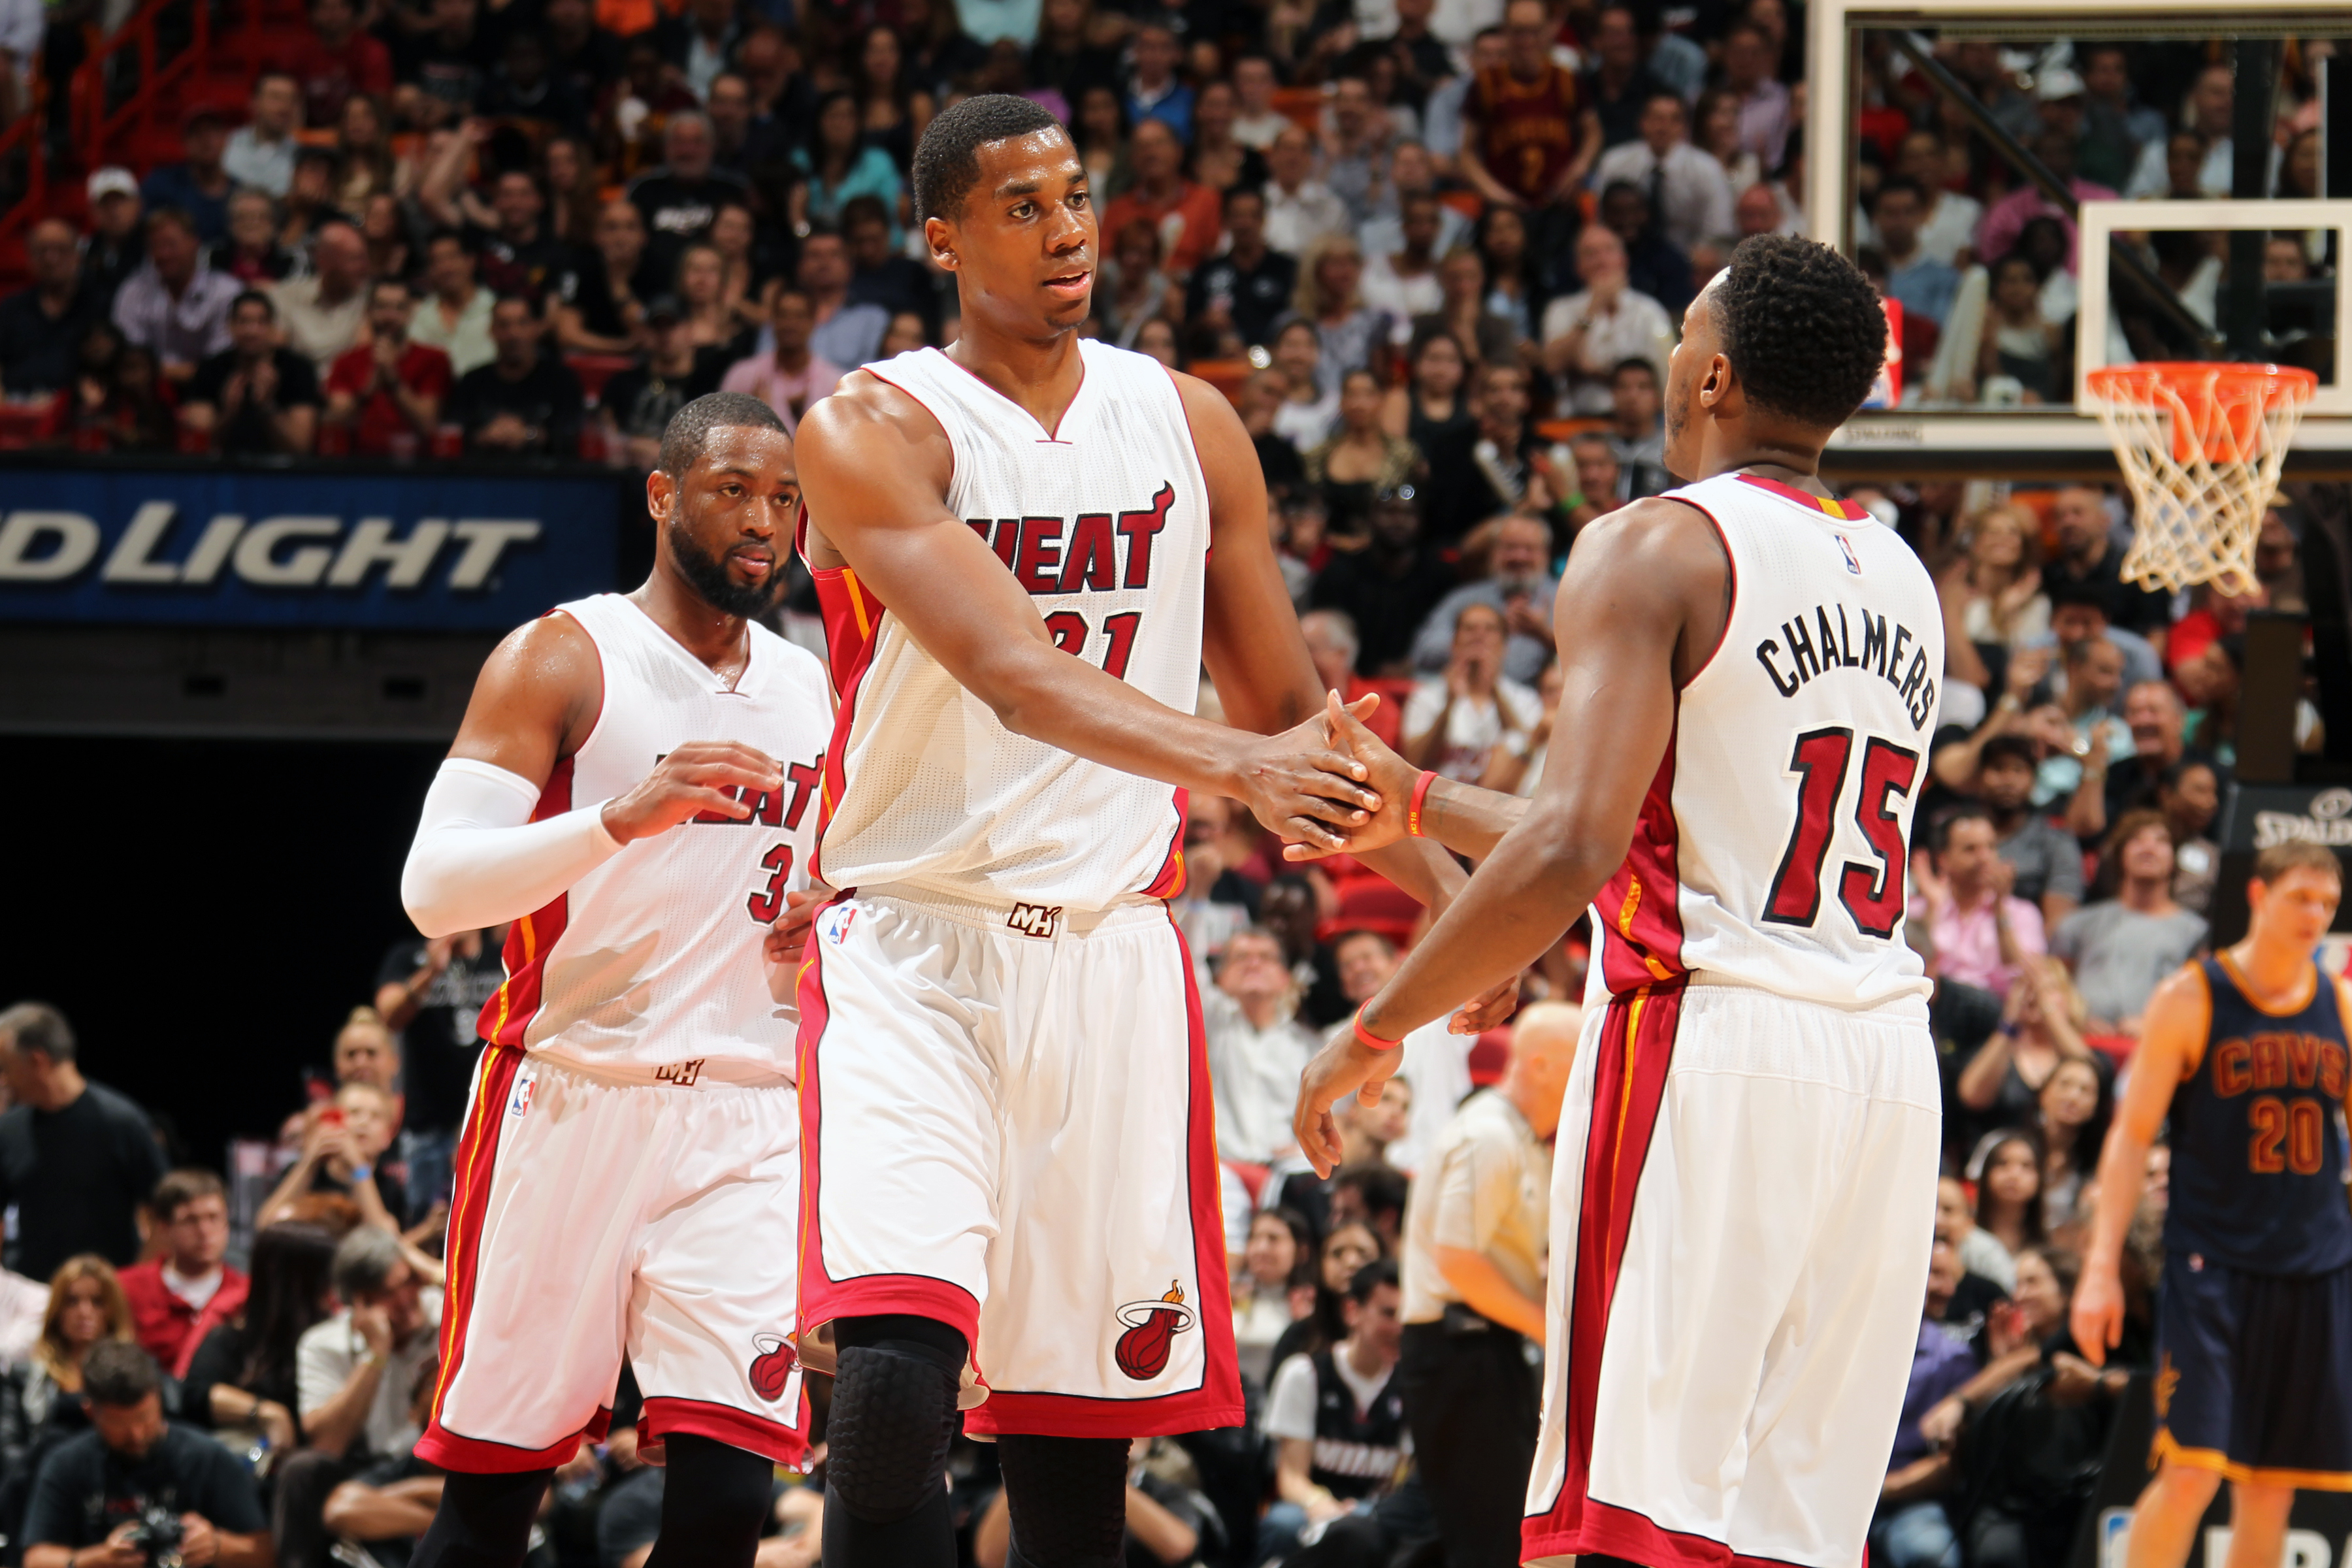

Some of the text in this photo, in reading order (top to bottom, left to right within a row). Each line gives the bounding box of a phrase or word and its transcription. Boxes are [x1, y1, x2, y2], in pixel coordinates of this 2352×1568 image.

[102, 502, 542, 589] LIGHT
[1756, 602, 1935, 731] CHALMERS
[655, 747, 825, 832] AT
[1756, 721, 1921, 943] 15
[745, 842, 794, 926] 3
[2212, 1030, 2347, 1100] CAVS
[2248, 1095, 2323, 1175] 20
[1315, 1437, 1401, 1478] MIAM
